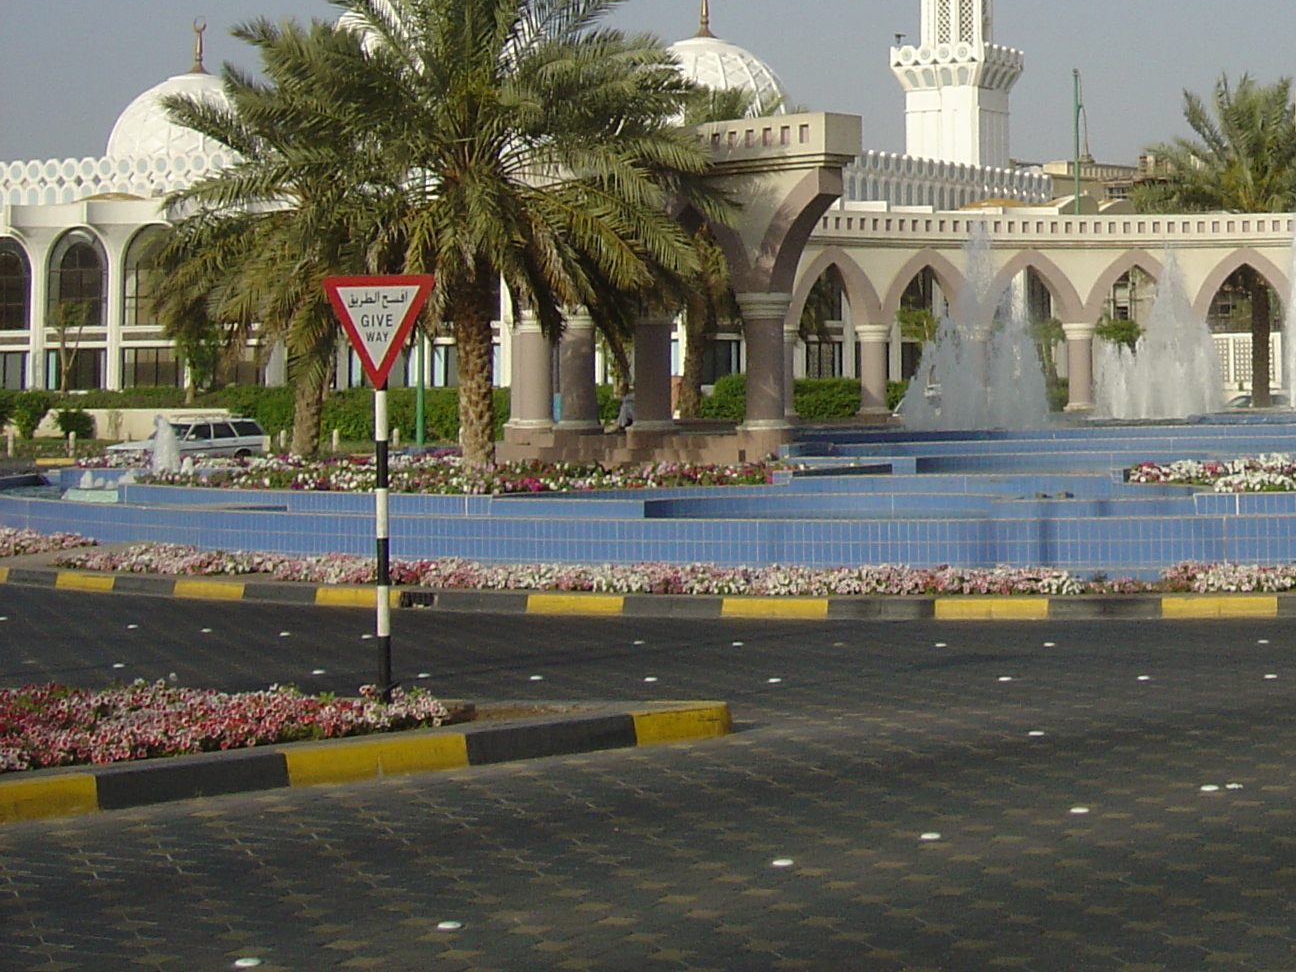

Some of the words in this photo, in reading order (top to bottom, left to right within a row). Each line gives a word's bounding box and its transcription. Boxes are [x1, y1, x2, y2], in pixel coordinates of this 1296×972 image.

[348, 291, 380, 308] الطريق
[381, 290, 408, 309] افسح
[361, 314, 393, 327] GIVE
[366, 332, 388, 342] WAY
